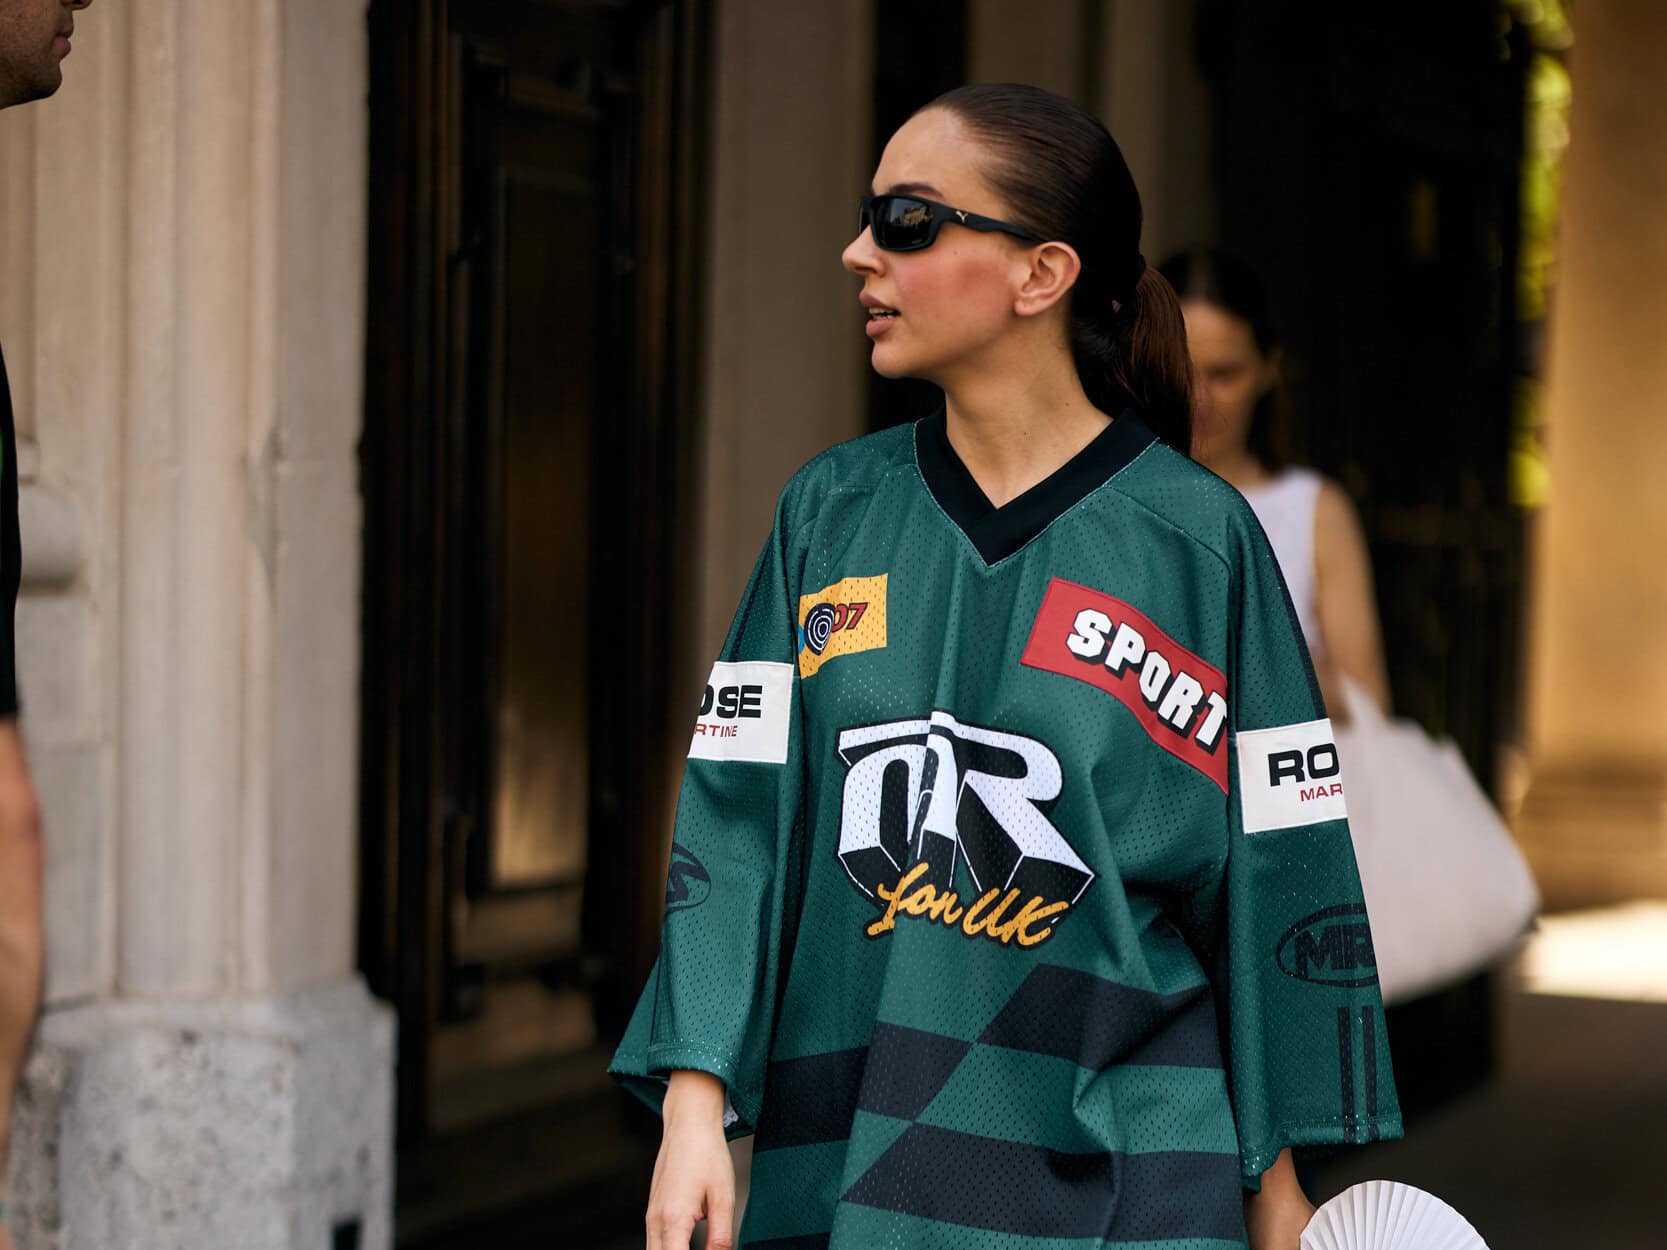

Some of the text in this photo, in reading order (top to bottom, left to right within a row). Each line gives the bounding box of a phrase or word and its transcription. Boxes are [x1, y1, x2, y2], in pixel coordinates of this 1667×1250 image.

[1065, 608, 1229, 757] SPORT
[1267, 742, 1340, 787] RO
[1300, 783, 1344, 802] MAR
